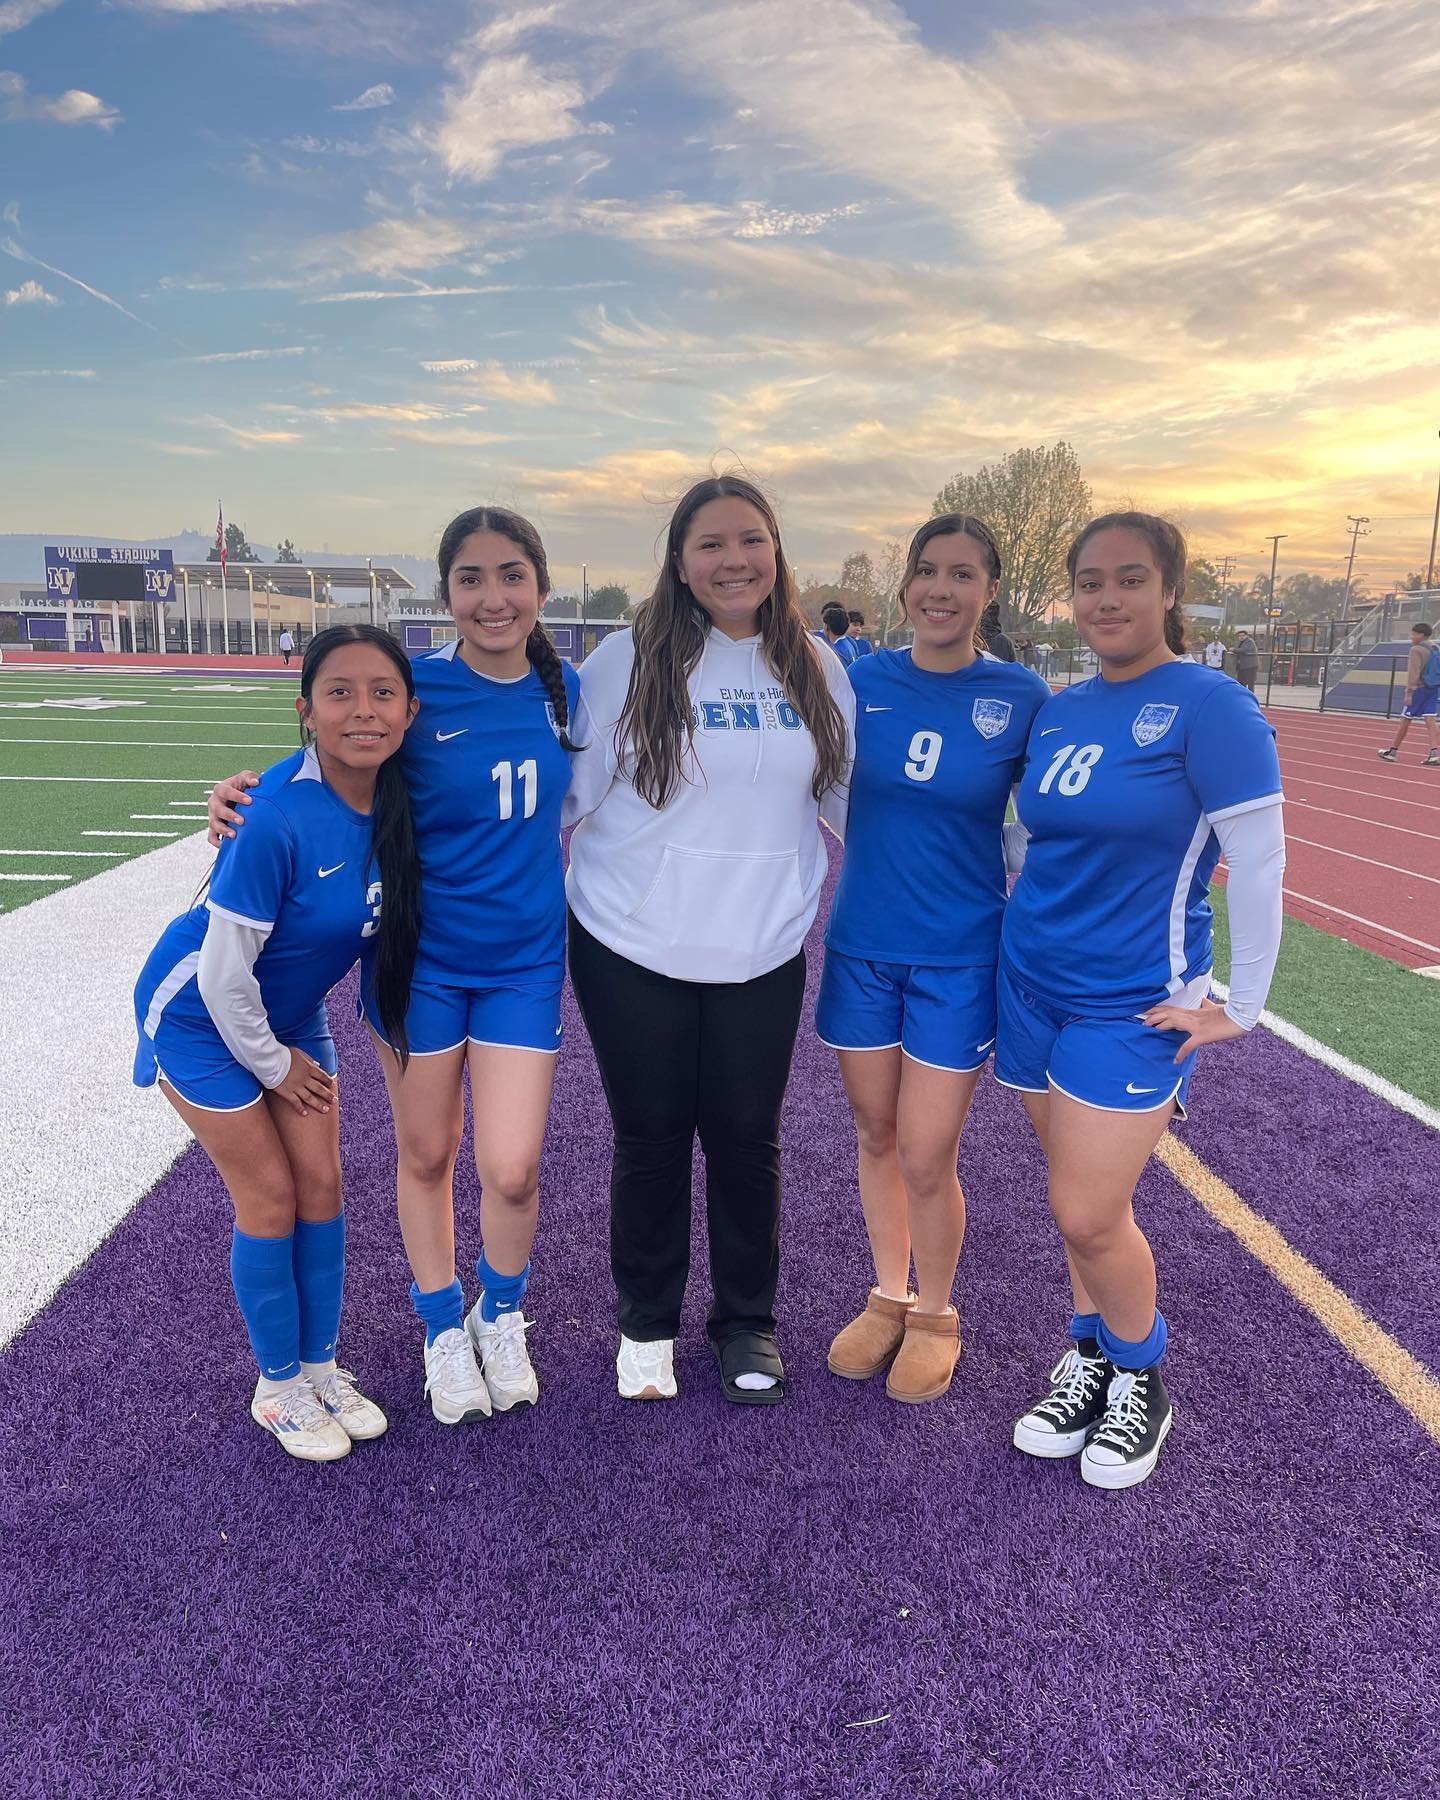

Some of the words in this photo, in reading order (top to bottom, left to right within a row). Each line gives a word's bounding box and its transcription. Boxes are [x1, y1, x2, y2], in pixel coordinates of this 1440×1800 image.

[58, 547, 98, 559] VIKING
[110, 549, 160, 560] STADIUM
[10, 599, 53, 609] NACK
[58, 600, 100, 609] SACK
[719, 689, 731, 700] El
[767, 687, 786, 700] Hig
[762, 701, 778, 731] 2025
[904, 730, 943, 782] 9
[1038, 744, 1104, 796] 18
[491, 759, 538, 821] 11
